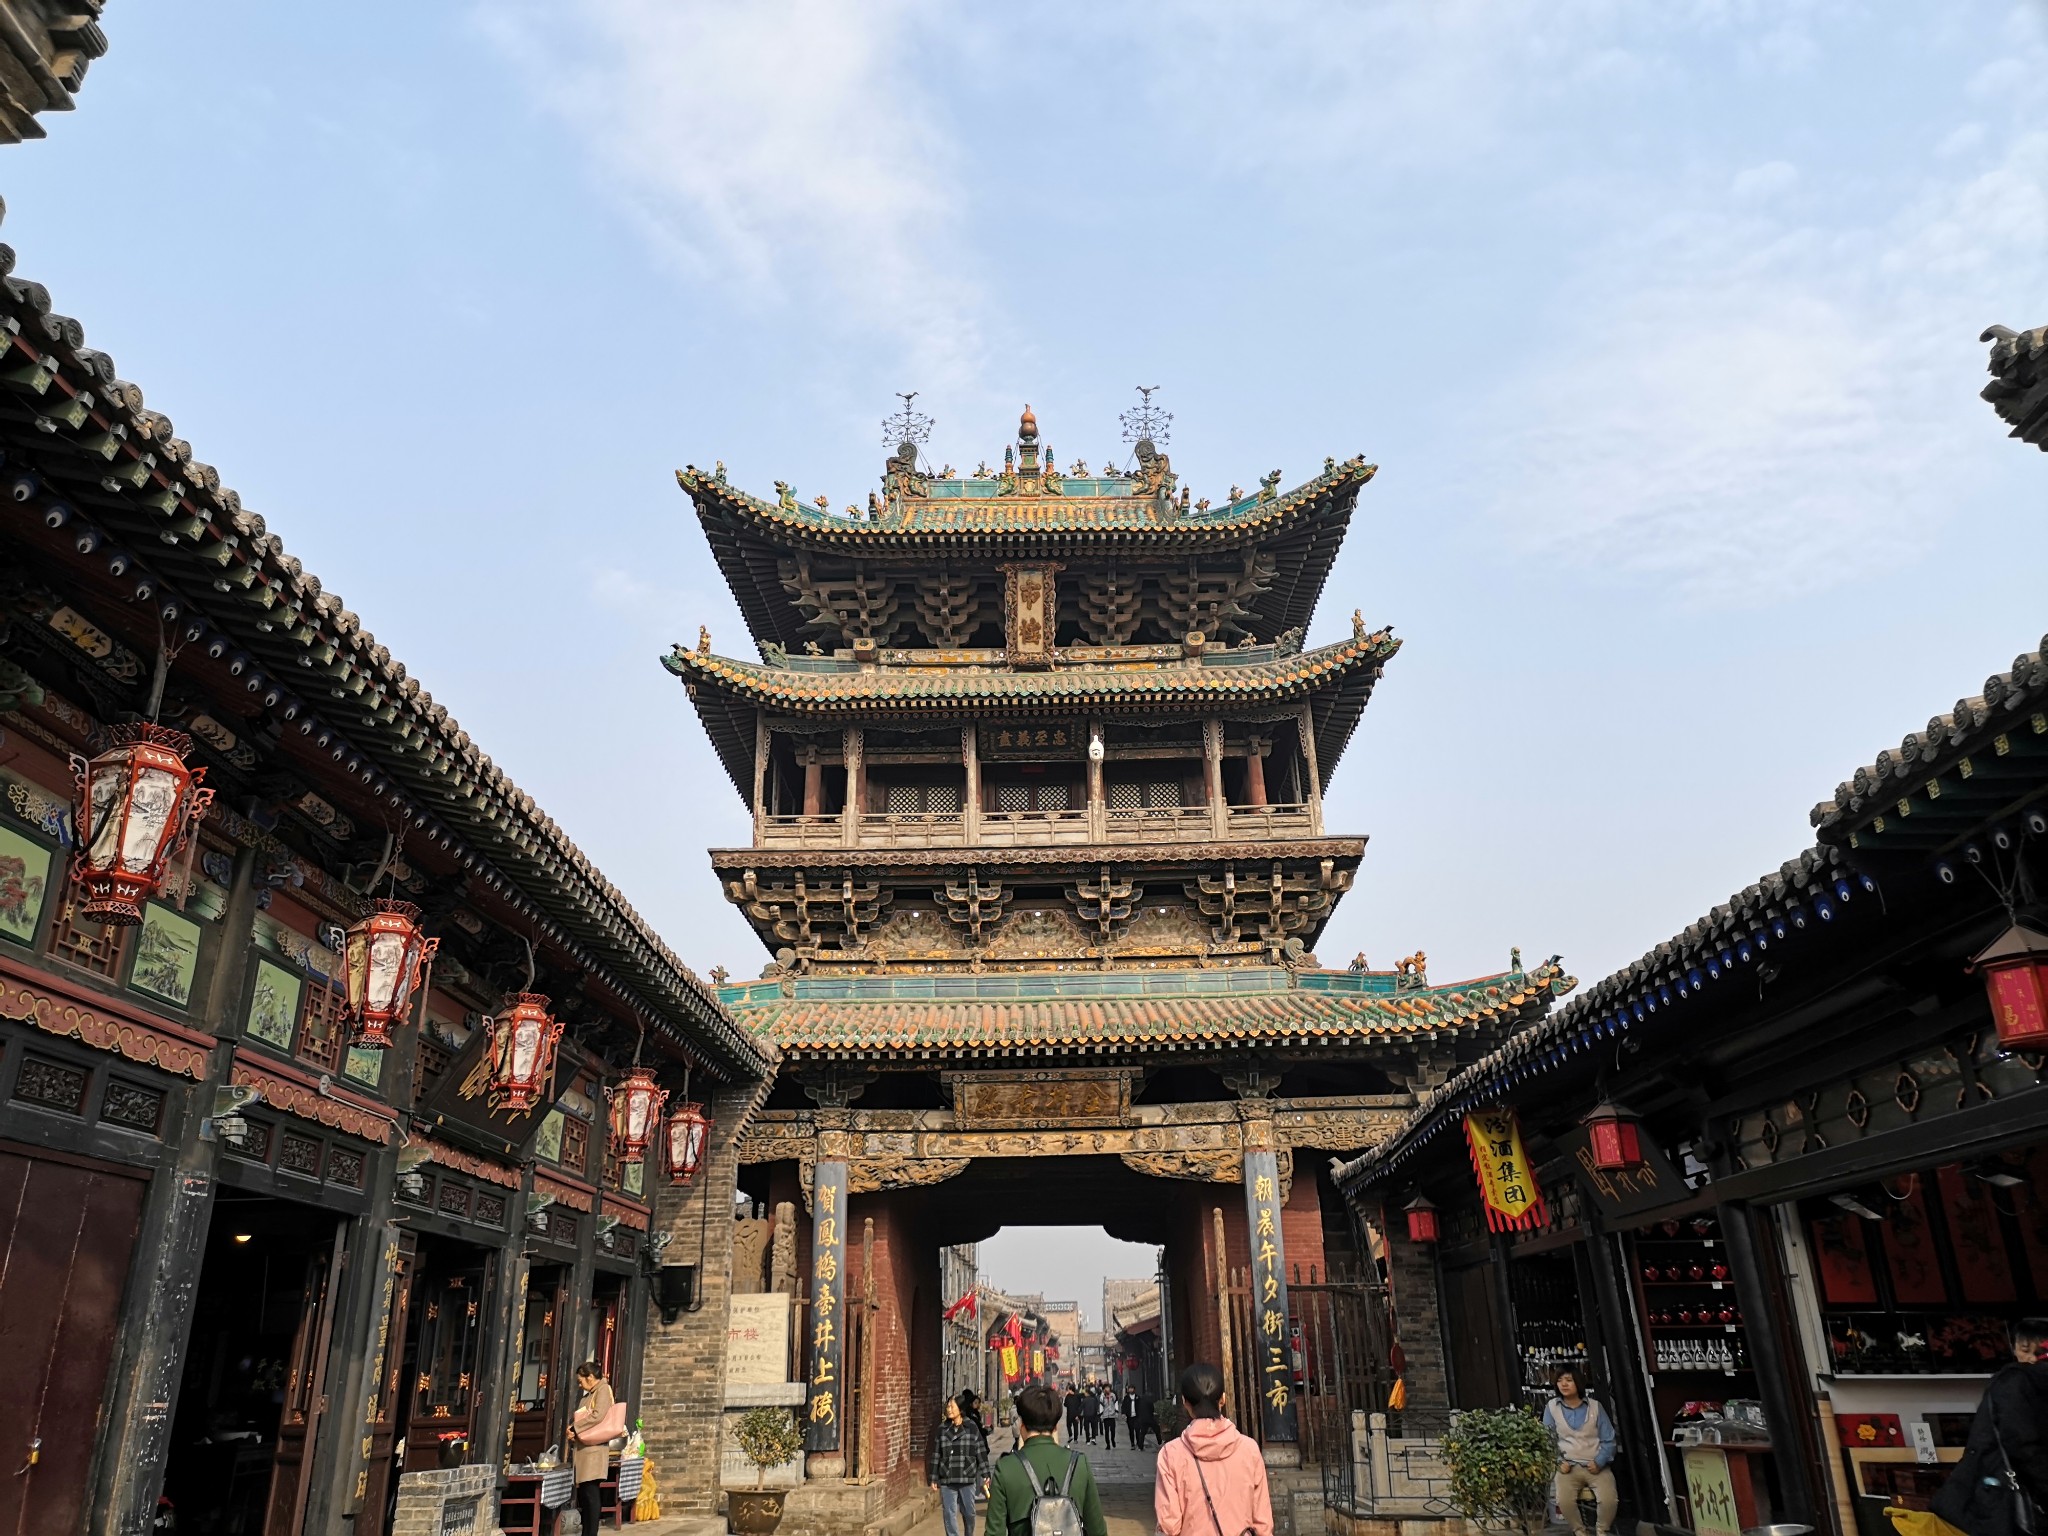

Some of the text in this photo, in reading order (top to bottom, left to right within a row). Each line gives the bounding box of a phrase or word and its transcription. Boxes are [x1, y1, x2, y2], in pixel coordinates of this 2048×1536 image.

[1484, 1117, 1527, 1204] 汾酒集团
[1253, 1174, 1289, 1416] 朝晨午夕街三市
